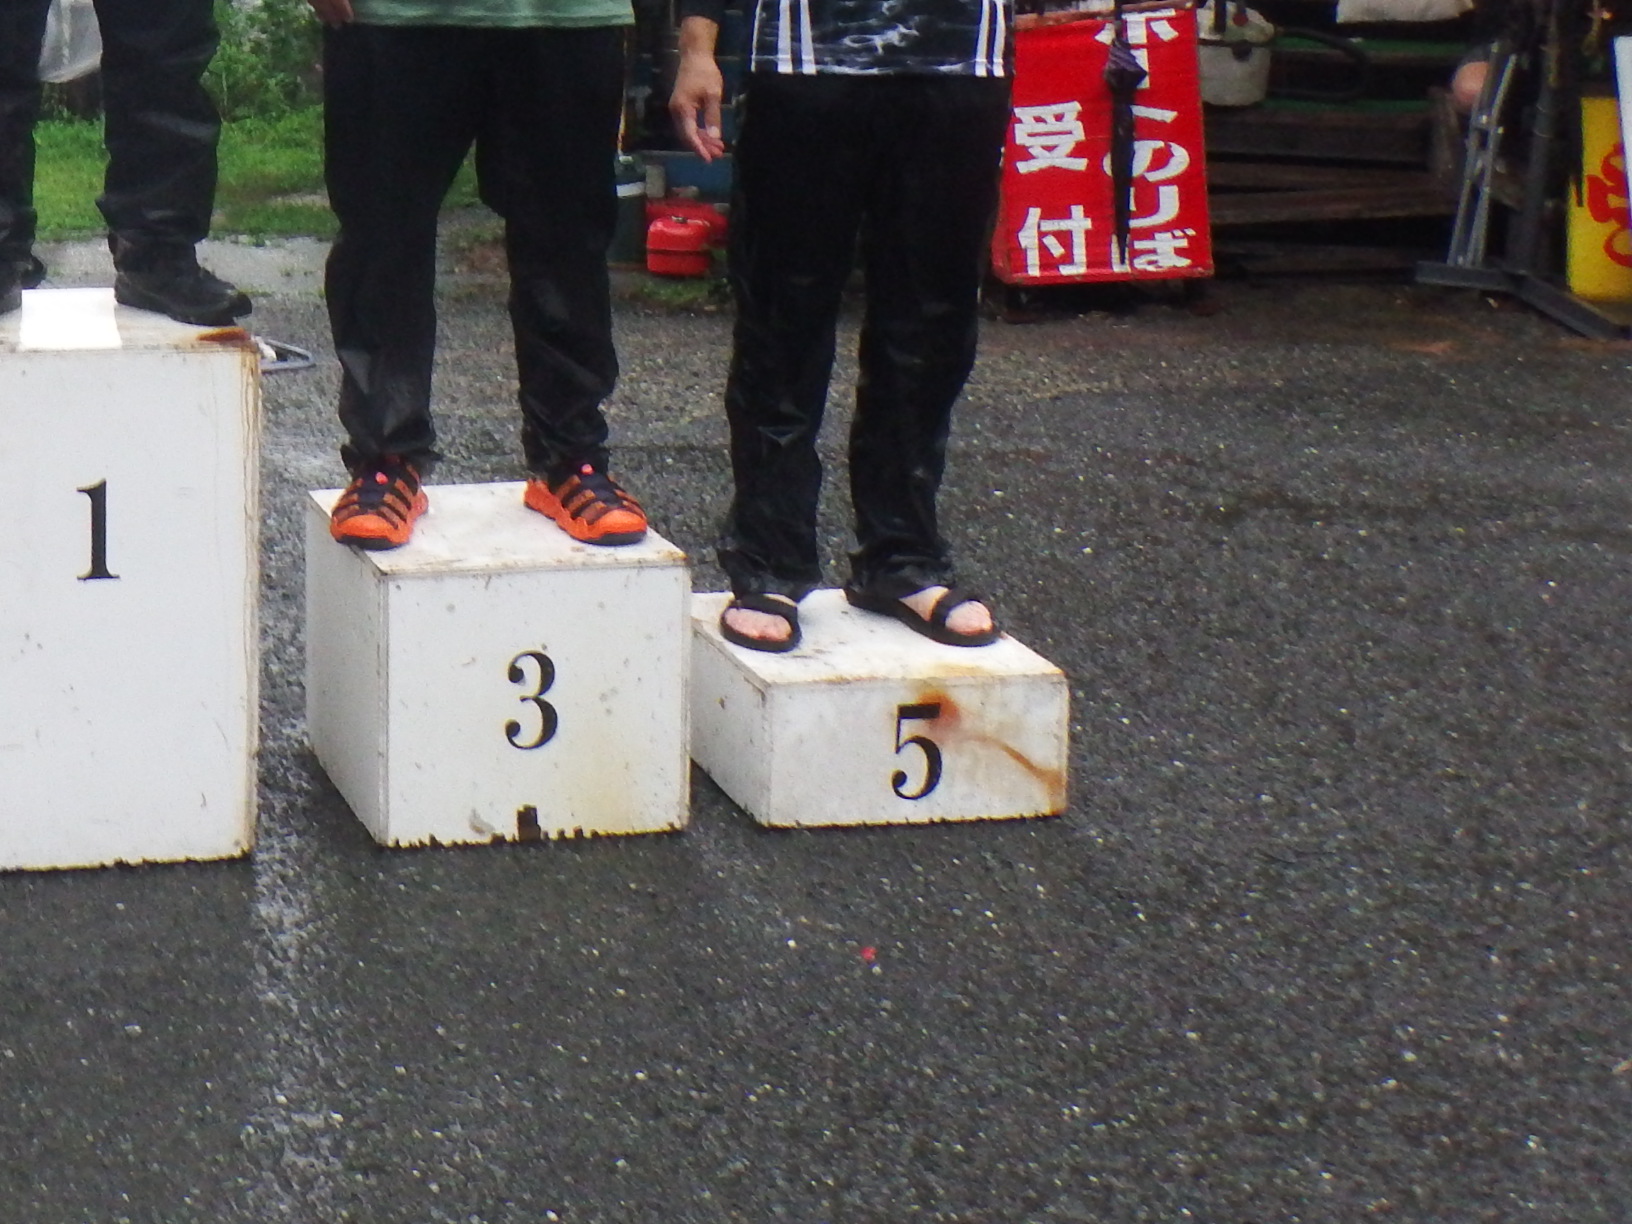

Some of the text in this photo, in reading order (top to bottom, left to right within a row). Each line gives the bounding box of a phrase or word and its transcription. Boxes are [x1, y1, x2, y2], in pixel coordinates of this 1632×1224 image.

[1013, 100, 1092, 277] 受付
[76, 478, 120, 581] 1
[505, 650, 558, 751] 3
[891, 702, 944, 801] 5
